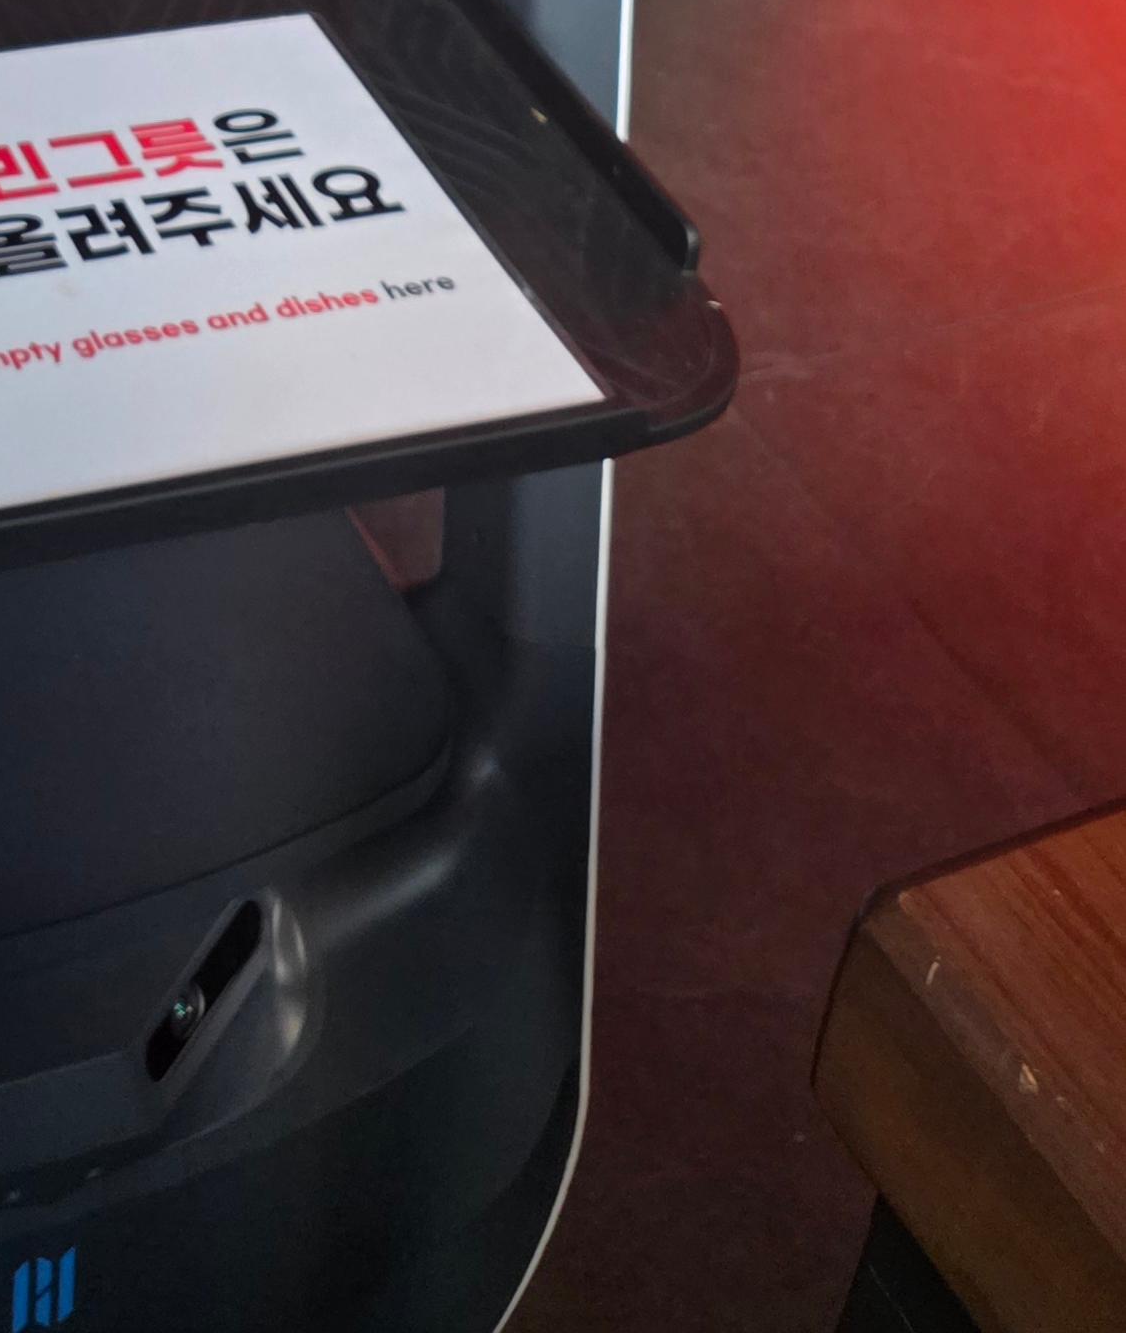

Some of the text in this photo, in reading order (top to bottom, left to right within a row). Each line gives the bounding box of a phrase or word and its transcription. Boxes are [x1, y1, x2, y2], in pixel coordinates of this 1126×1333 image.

[71, 320, 200, 360] glasses
[207, 303, 270, 331] and
[276, 289, 379, 319] dishes
[382, 276, 456, 300] here
